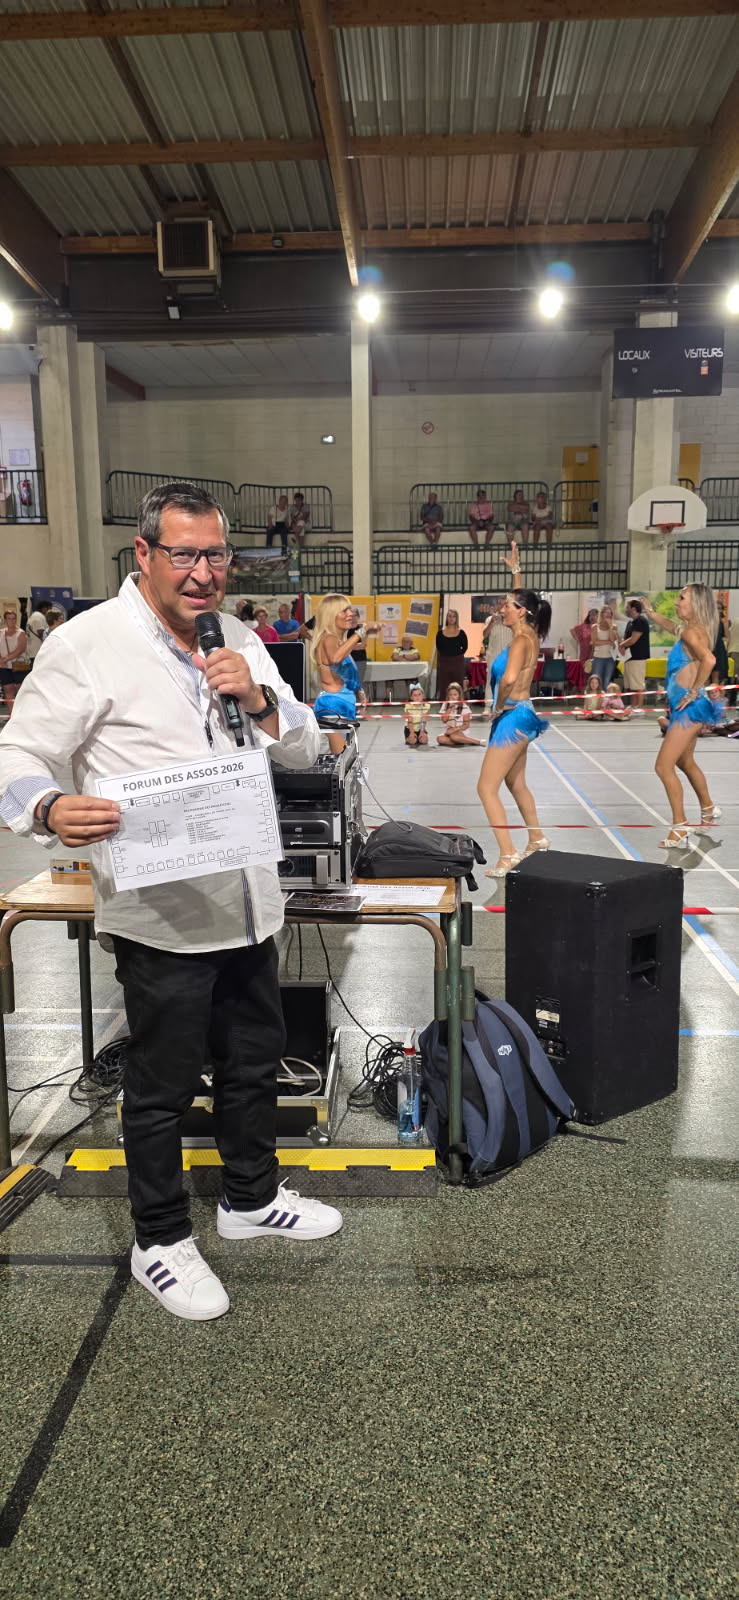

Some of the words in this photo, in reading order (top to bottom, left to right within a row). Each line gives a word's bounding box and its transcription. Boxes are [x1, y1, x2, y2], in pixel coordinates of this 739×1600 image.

[618, 350, 650, 360] LOCAUX
[684, 347, 723, 359] VISITEURS
[123, 776, 162, 792] FORUM
[165, 773, 184, 785] DES
[186, 766, 218, 781] ASSOS
[221, 761, 244, 774] 2026
